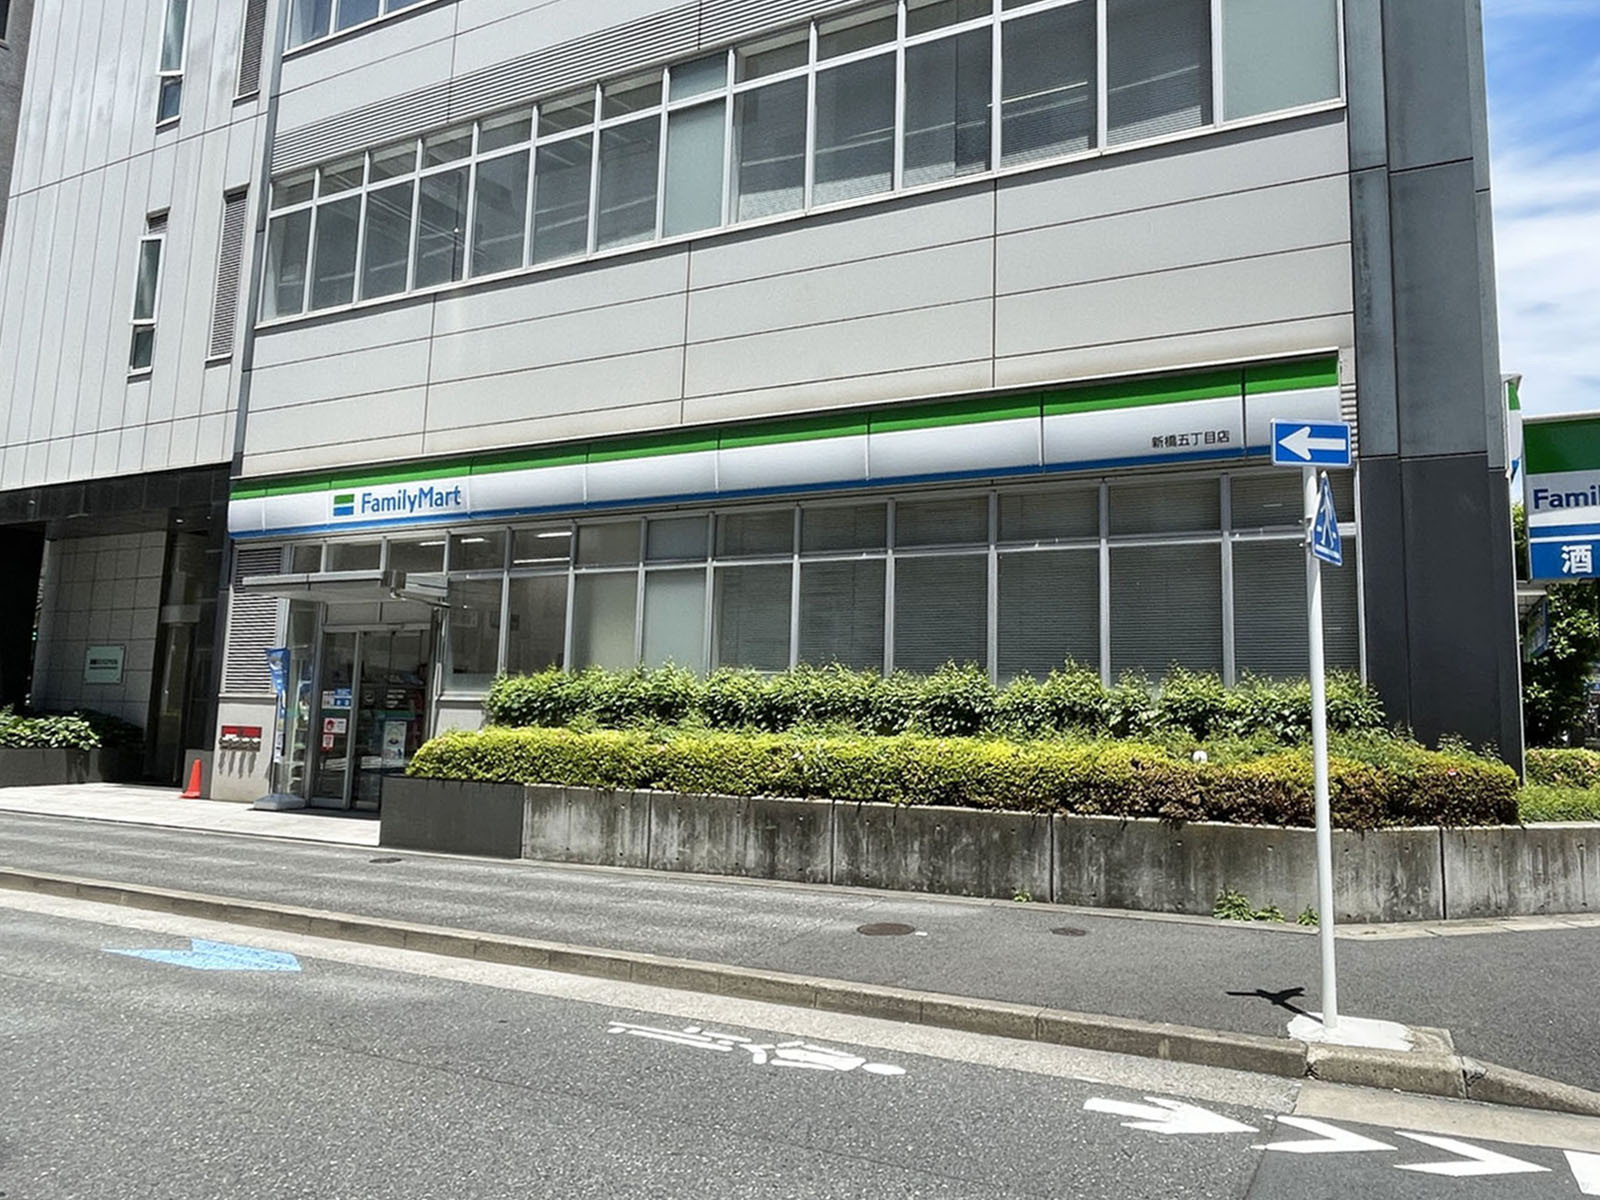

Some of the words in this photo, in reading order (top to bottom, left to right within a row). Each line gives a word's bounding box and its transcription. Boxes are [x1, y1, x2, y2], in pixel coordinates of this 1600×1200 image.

[1151, 430, 1230, 448] 新橋五丁目店
[361, 485, 462, 513] FamilyMart
[1561, 544, 1593, 574] 酒
